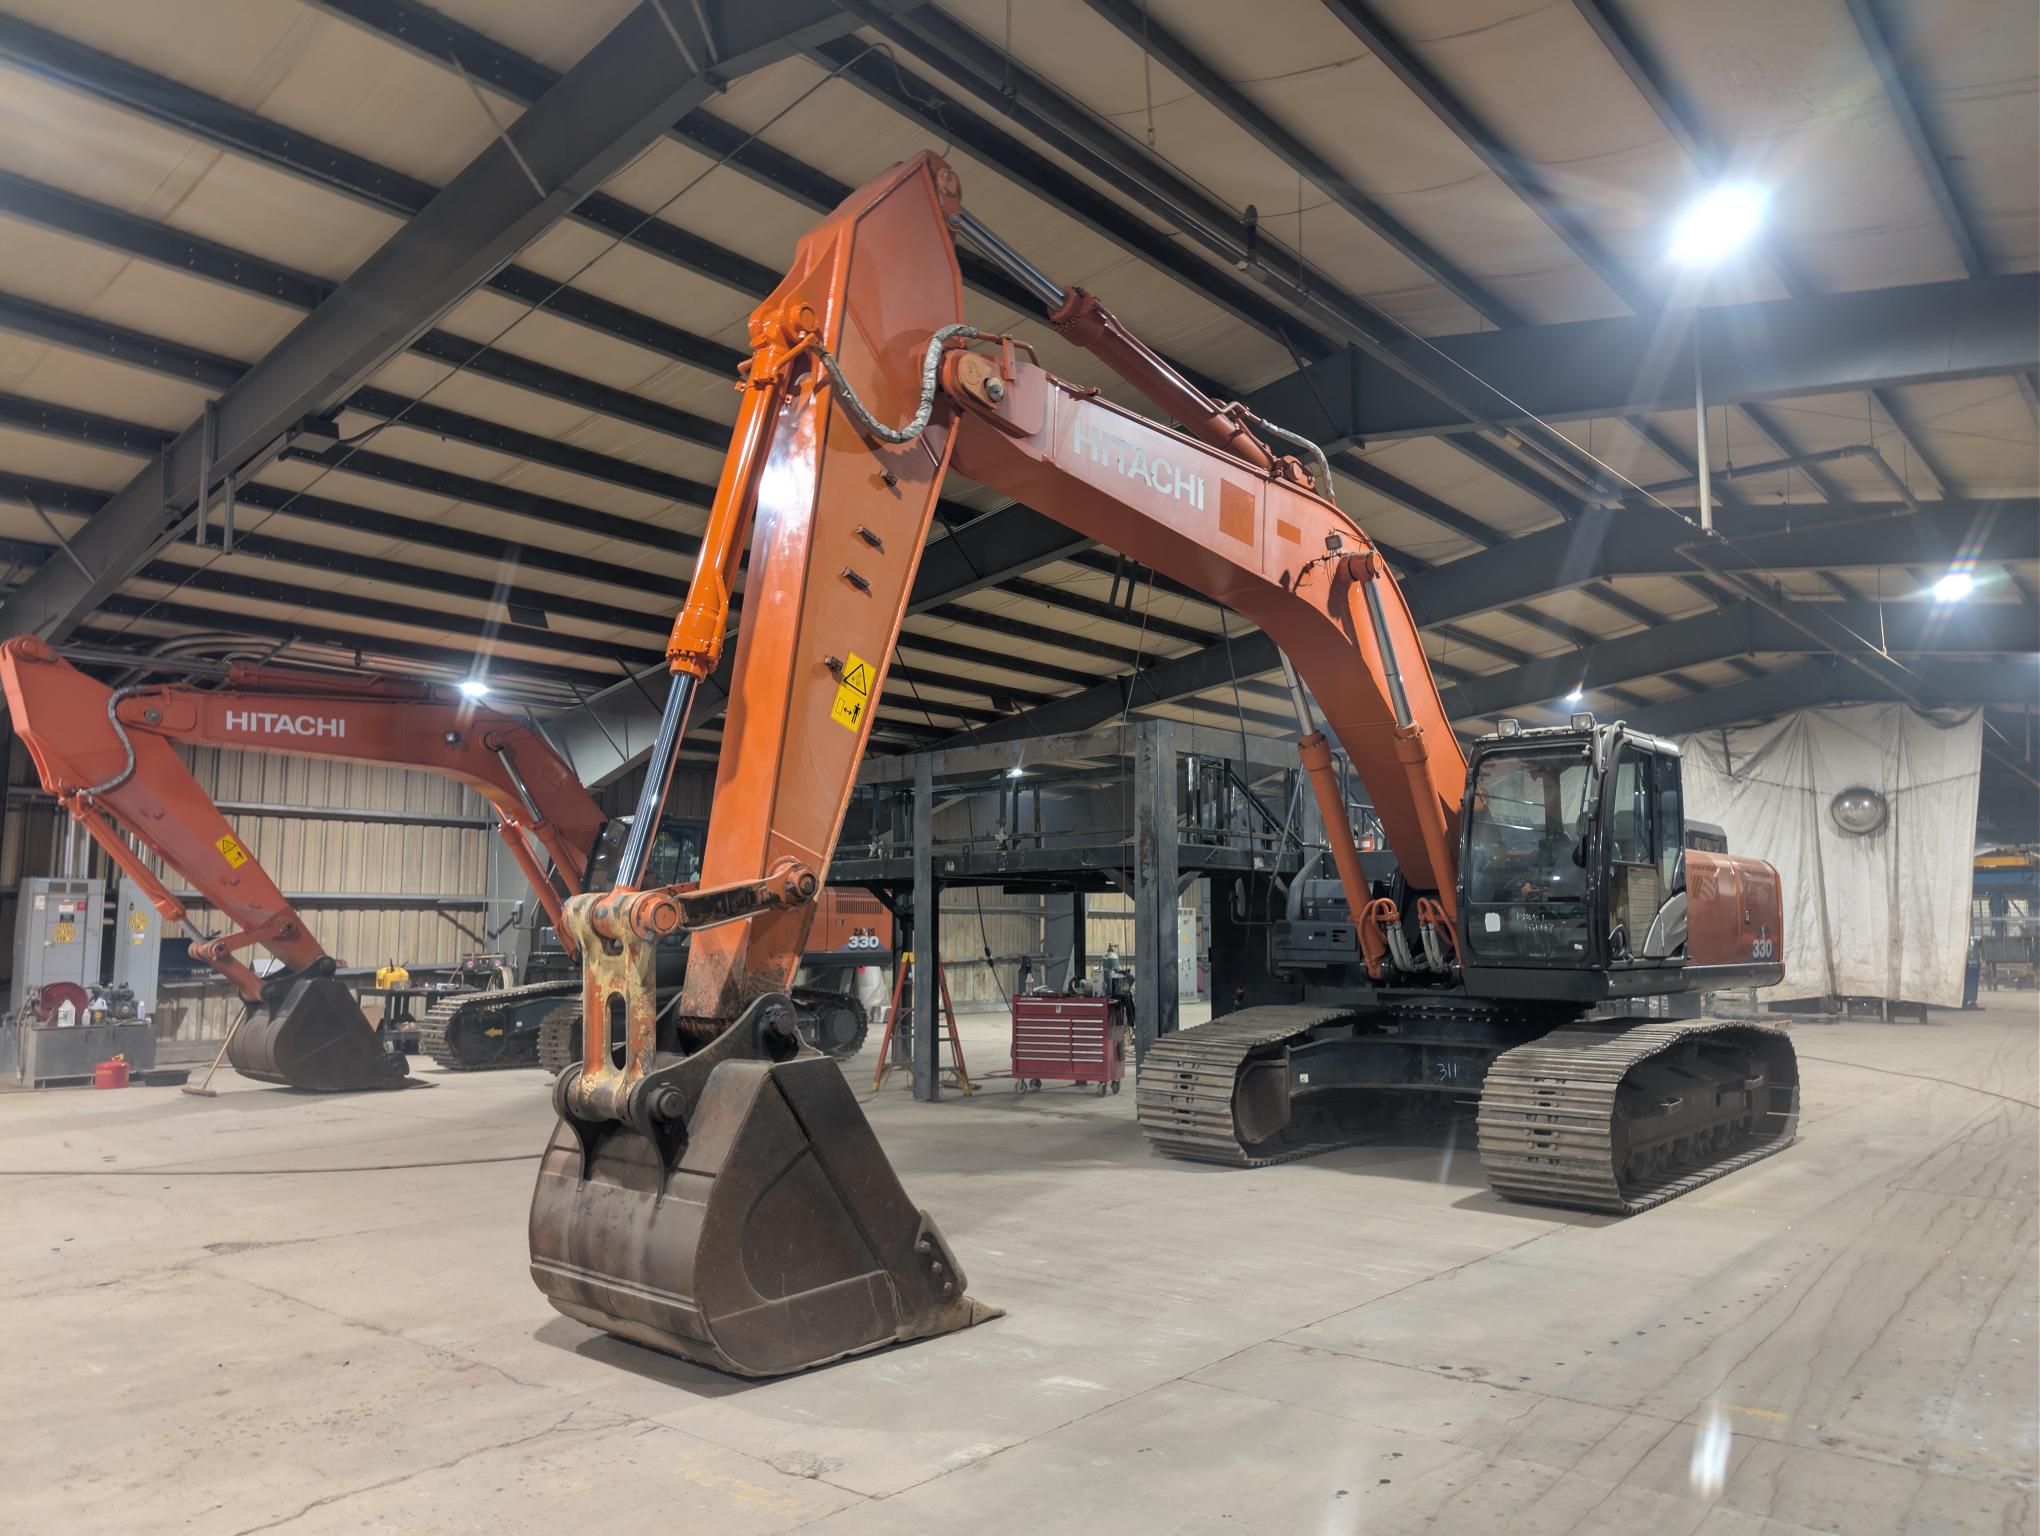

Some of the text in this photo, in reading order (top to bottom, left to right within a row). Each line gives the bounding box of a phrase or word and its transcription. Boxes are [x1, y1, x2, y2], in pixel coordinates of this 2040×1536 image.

[1073, 418, 1204, 511] HITACHI
[226, 710, 345, 738] HITACHI
[848, 935, 880, 949] 330
[1753, 939, 1773, 958] 330
[1436, 1063, 1457, 1081] 311
